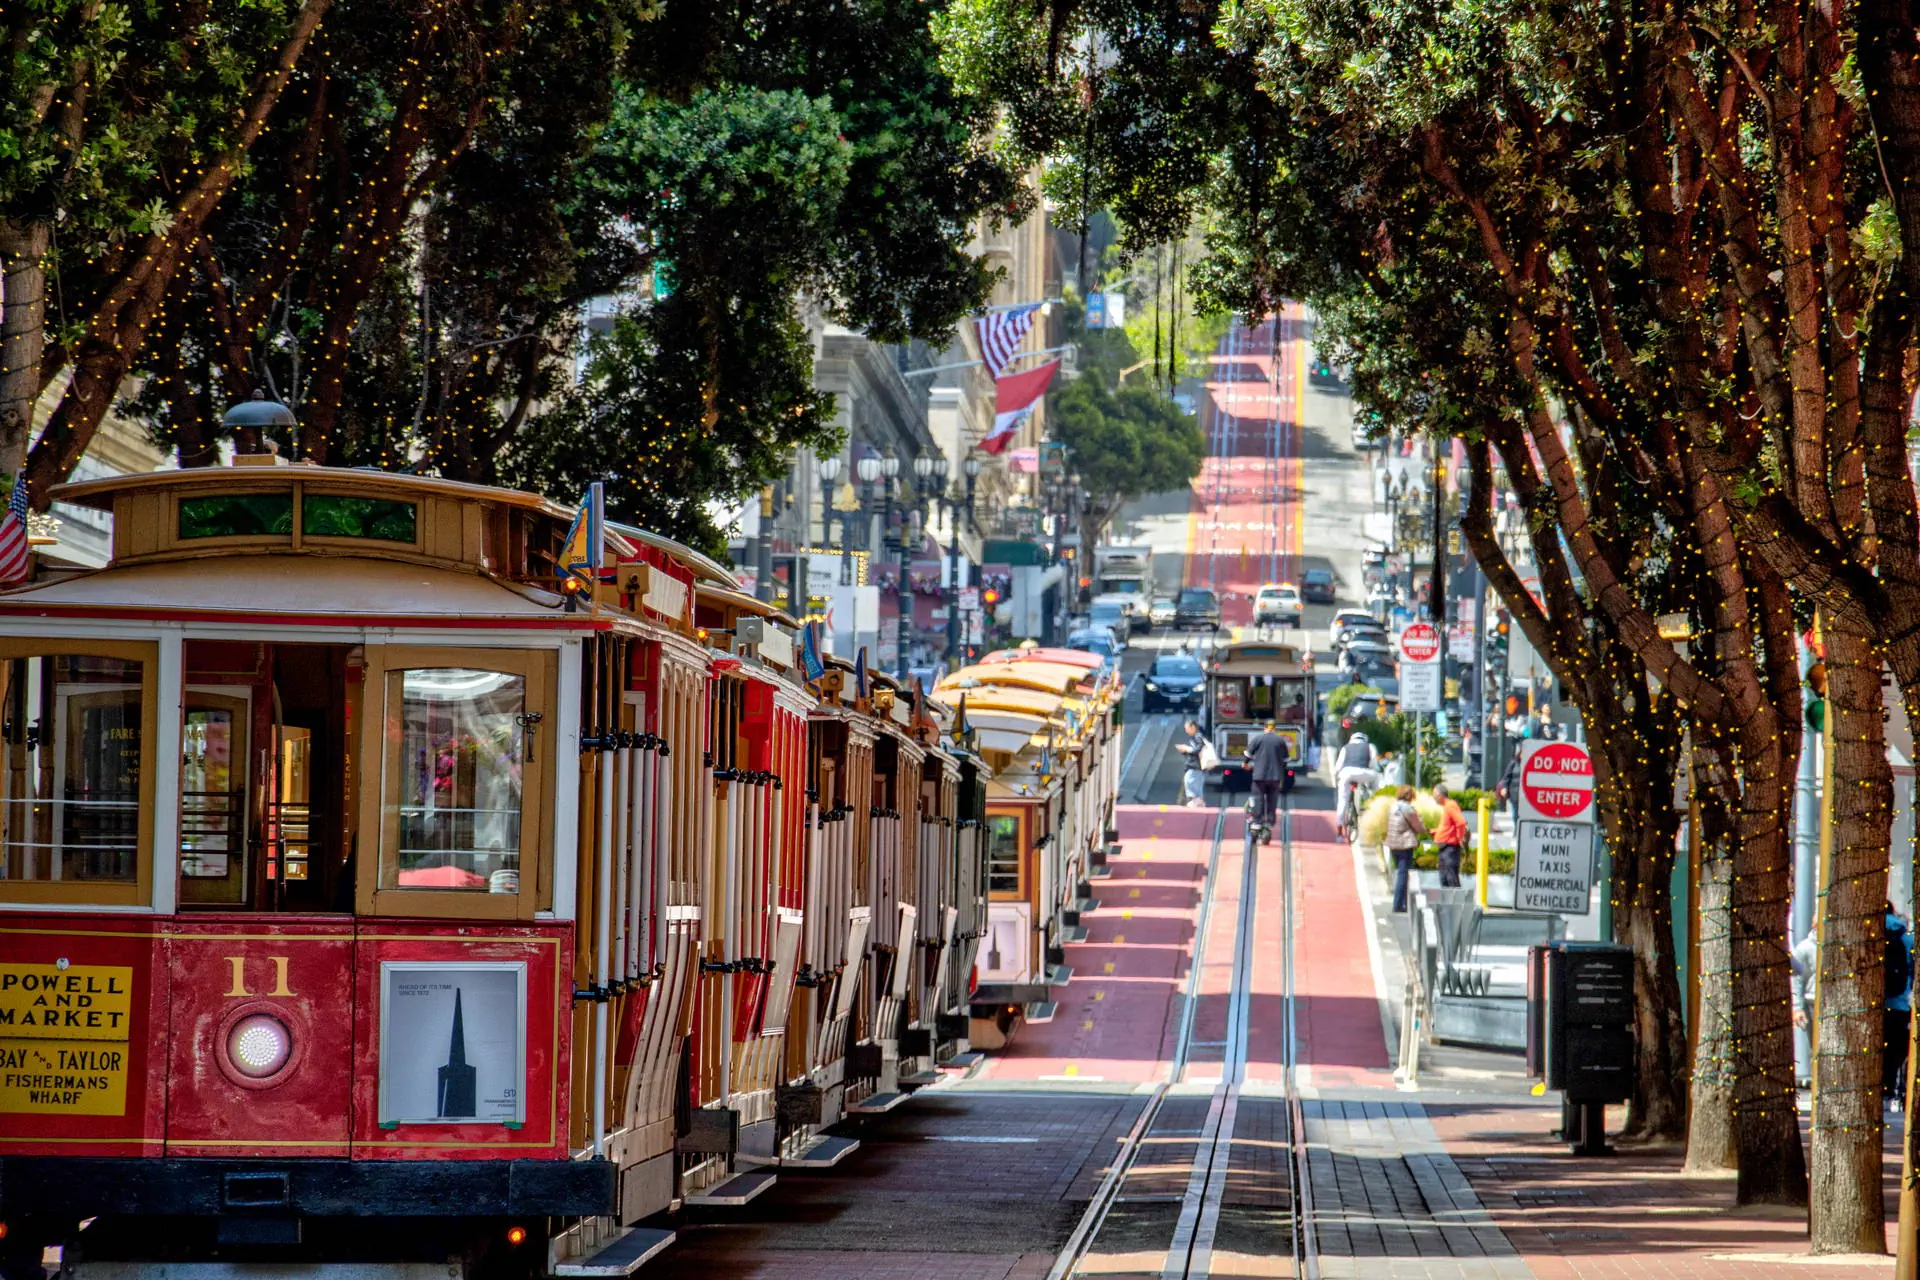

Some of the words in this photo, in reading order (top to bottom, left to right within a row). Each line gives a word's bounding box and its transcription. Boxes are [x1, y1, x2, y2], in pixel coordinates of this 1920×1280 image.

[1408, 647, 1432, 655] ENTER
[1533, 756, 1553, 770] DO
[1560, 757, 1589, 773] NOT
[1536, 790, 1581, 807] ENTER
[1534, 826, 1578, 841] EXCEPT
[1541, 844, 1570, 857] MUNI
[1539, 860, 1571, 874] TAXIS
[1519, 876, 1586, 893] COMMERCIAL
[1525, 894, 1580, 910] VEHICLES
[2, 973, 124, 995] POWELL
[223, 956, 299, 997] 11
[32, 994, 93, 1008] AND
[0, 1008, 124, 1028] MARKET
[58, 1049, 121, 1071] TAYLOR
[5, 1073, 108, 1090] FISHERMANS
[29, 1090, 83, 1105] WHARF
